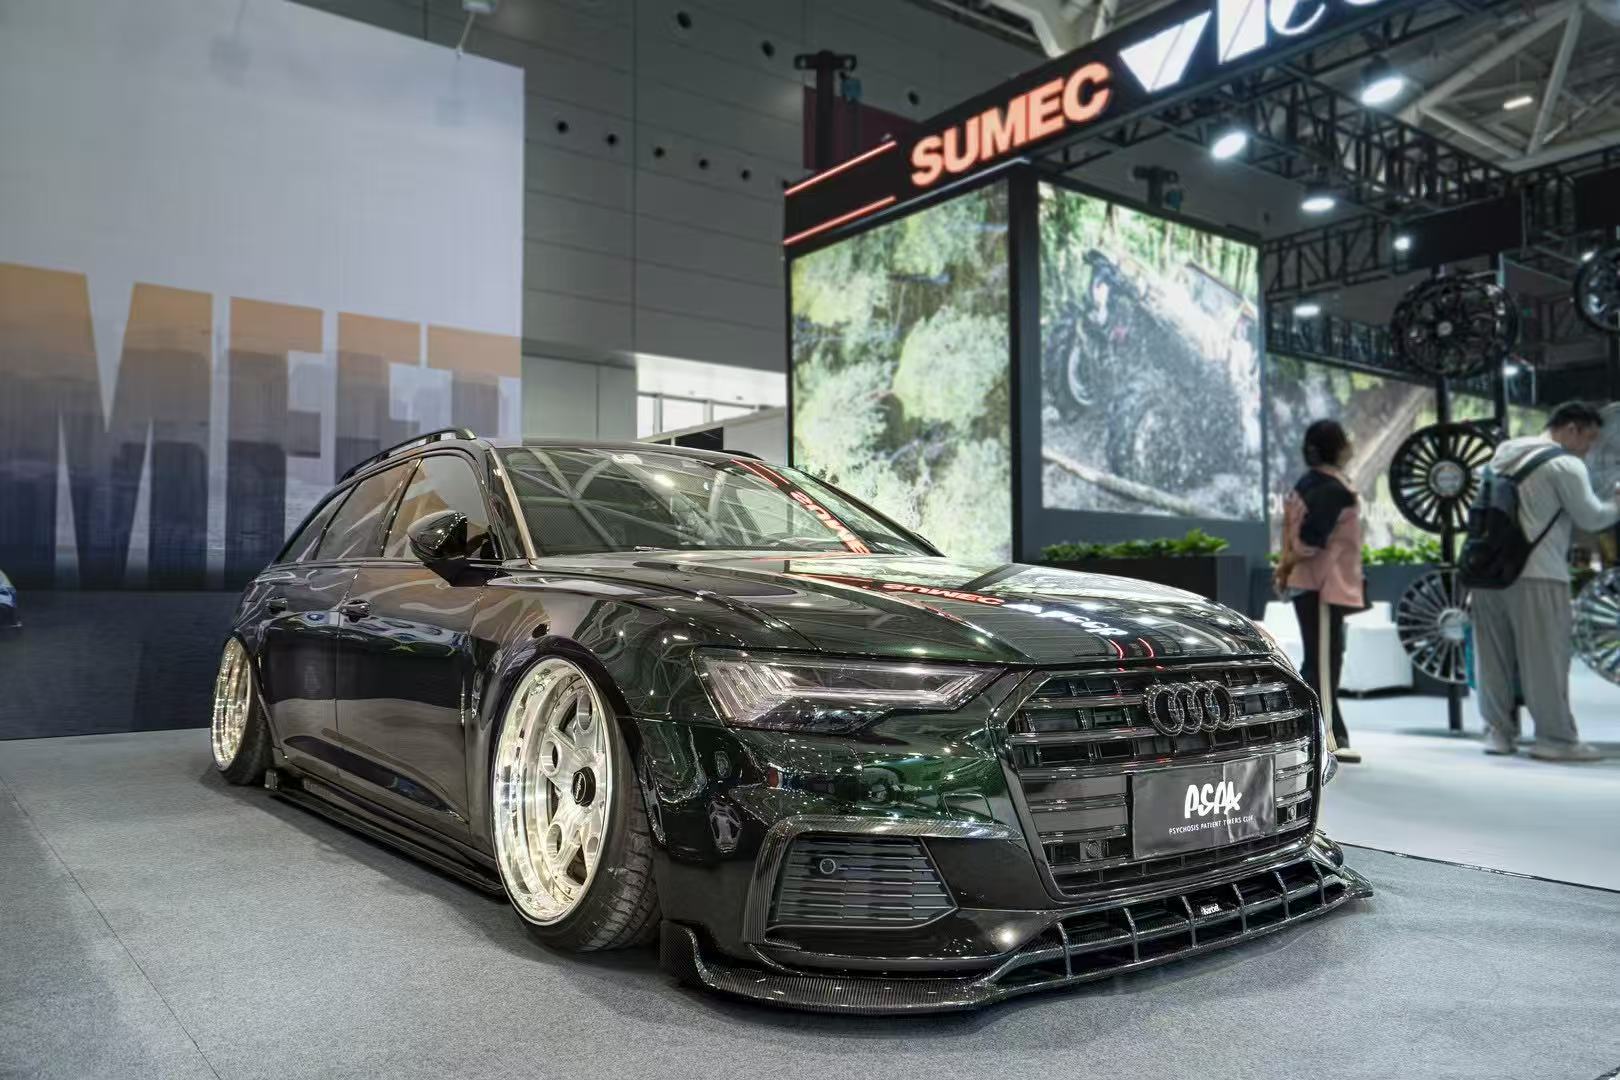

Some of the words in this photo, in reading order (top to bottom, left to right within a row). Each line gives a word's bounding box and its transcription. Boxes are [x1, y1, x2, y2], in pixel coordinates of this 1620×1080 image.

[911, 62, 1111, 185] SUMEC
[1169, 824, 1200, 835] PSYCHOSIS
[1201, 820, 1221, 830] PATIENT
